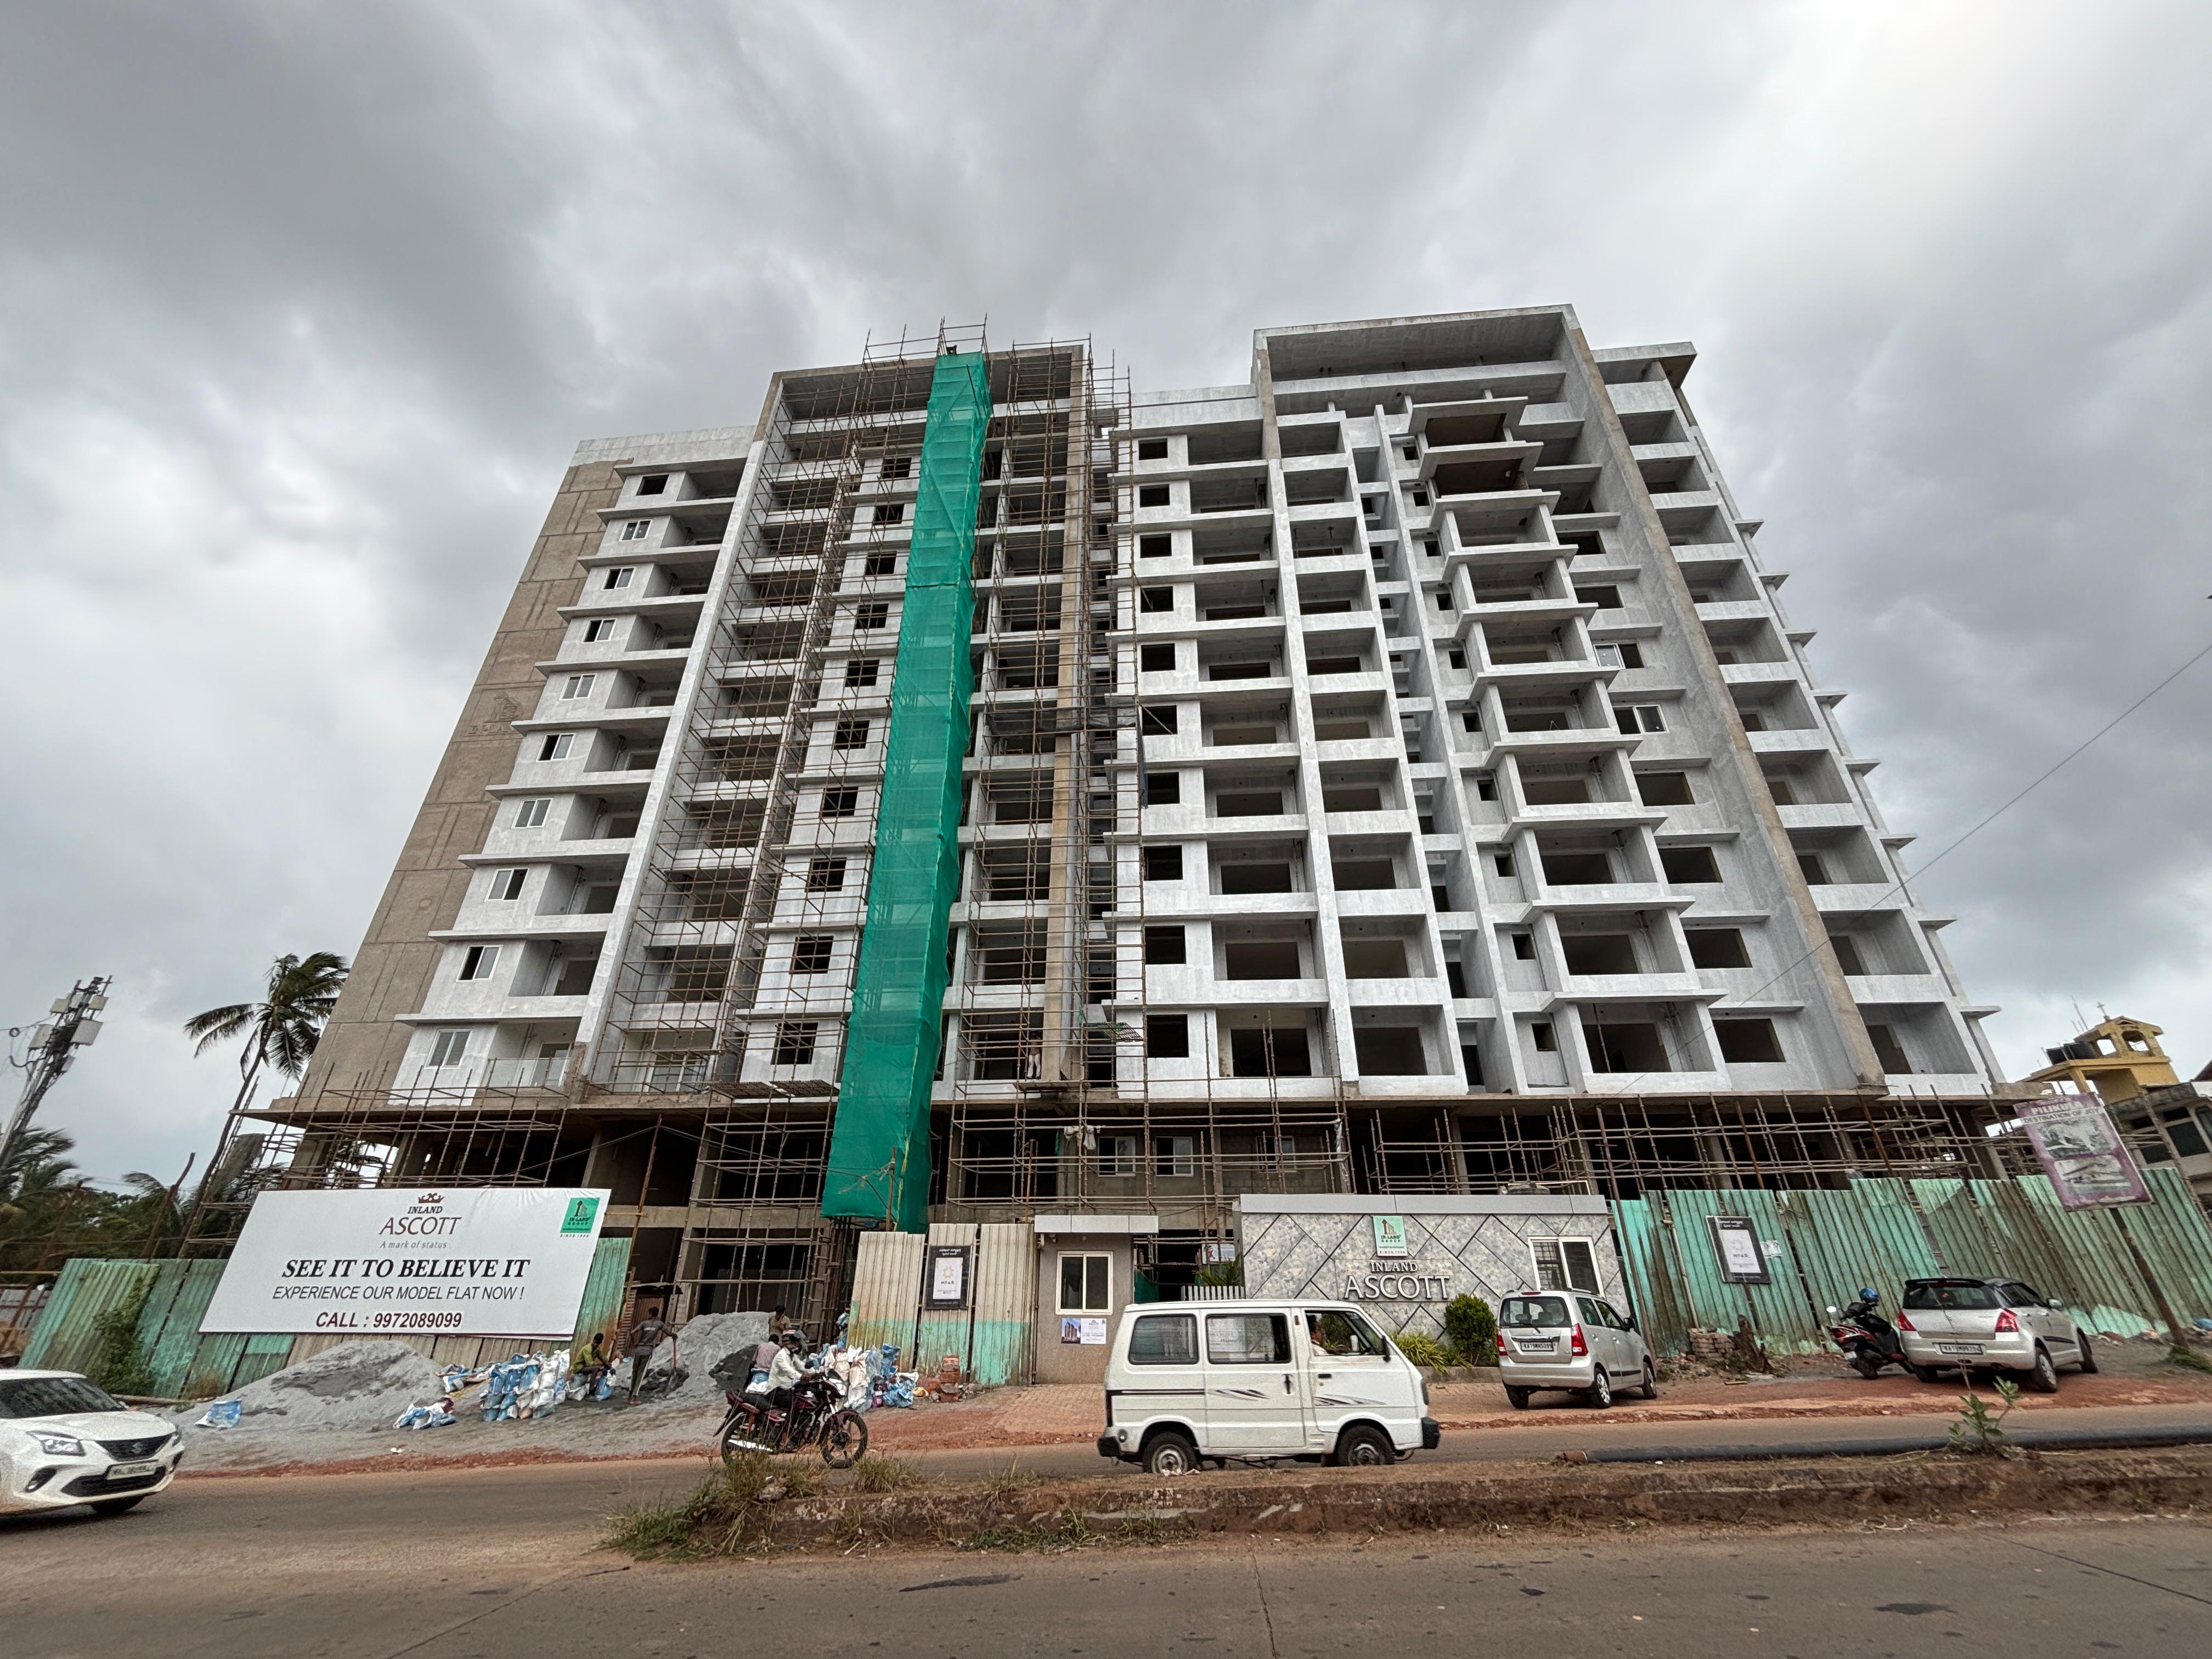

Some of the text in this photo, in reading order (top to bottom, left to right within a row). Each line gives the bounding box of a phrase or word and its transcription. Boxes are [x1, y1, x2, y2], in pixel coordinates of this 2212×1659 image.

[2023, 1112, 2070, 1123] DESTINATION
[379, 1216, 462, 1234] ASCOTT
[281, 1259, 531, 1278] SEE IT TO BELIEVE IT
[1370, 1262, 1418, 1272] INLAND
[273, 1286, 360, 1299] EXPERIENCE
[363, 1286, 394, 1299] OUR
[396, 1286, 443, 1300] MODEL
[446, 1286, 481, 1300] FLAT
[482, 1286, 517, 1300] NOW
[1344, 1274, 1451, 1299] ASCOTT
[316, 1312, 358, 1328] CALL
[373, 1312, 462, 1328] 9972089099
